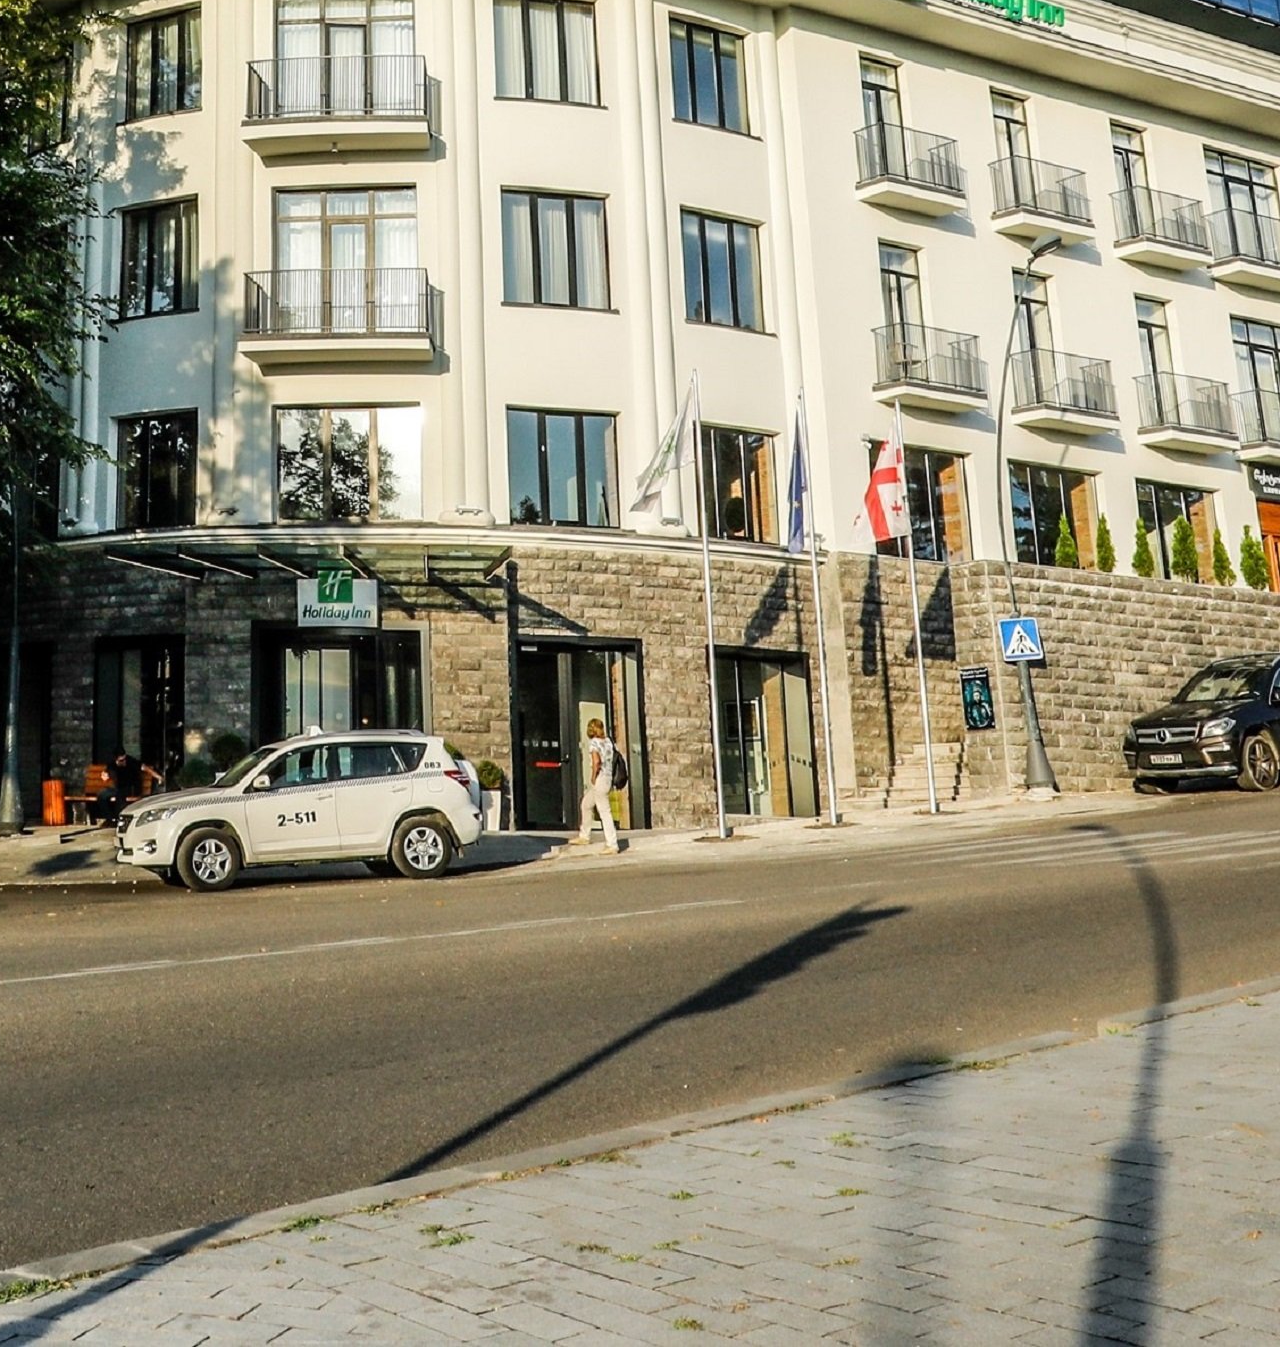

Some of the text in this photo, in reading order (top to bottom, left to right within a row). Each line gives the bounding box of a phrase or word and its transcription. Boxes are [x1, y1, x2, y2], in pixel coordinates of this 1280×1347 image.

[303, 604, 371, 620] Holiday Inn
[277, 811, 317, 827] 2-511
